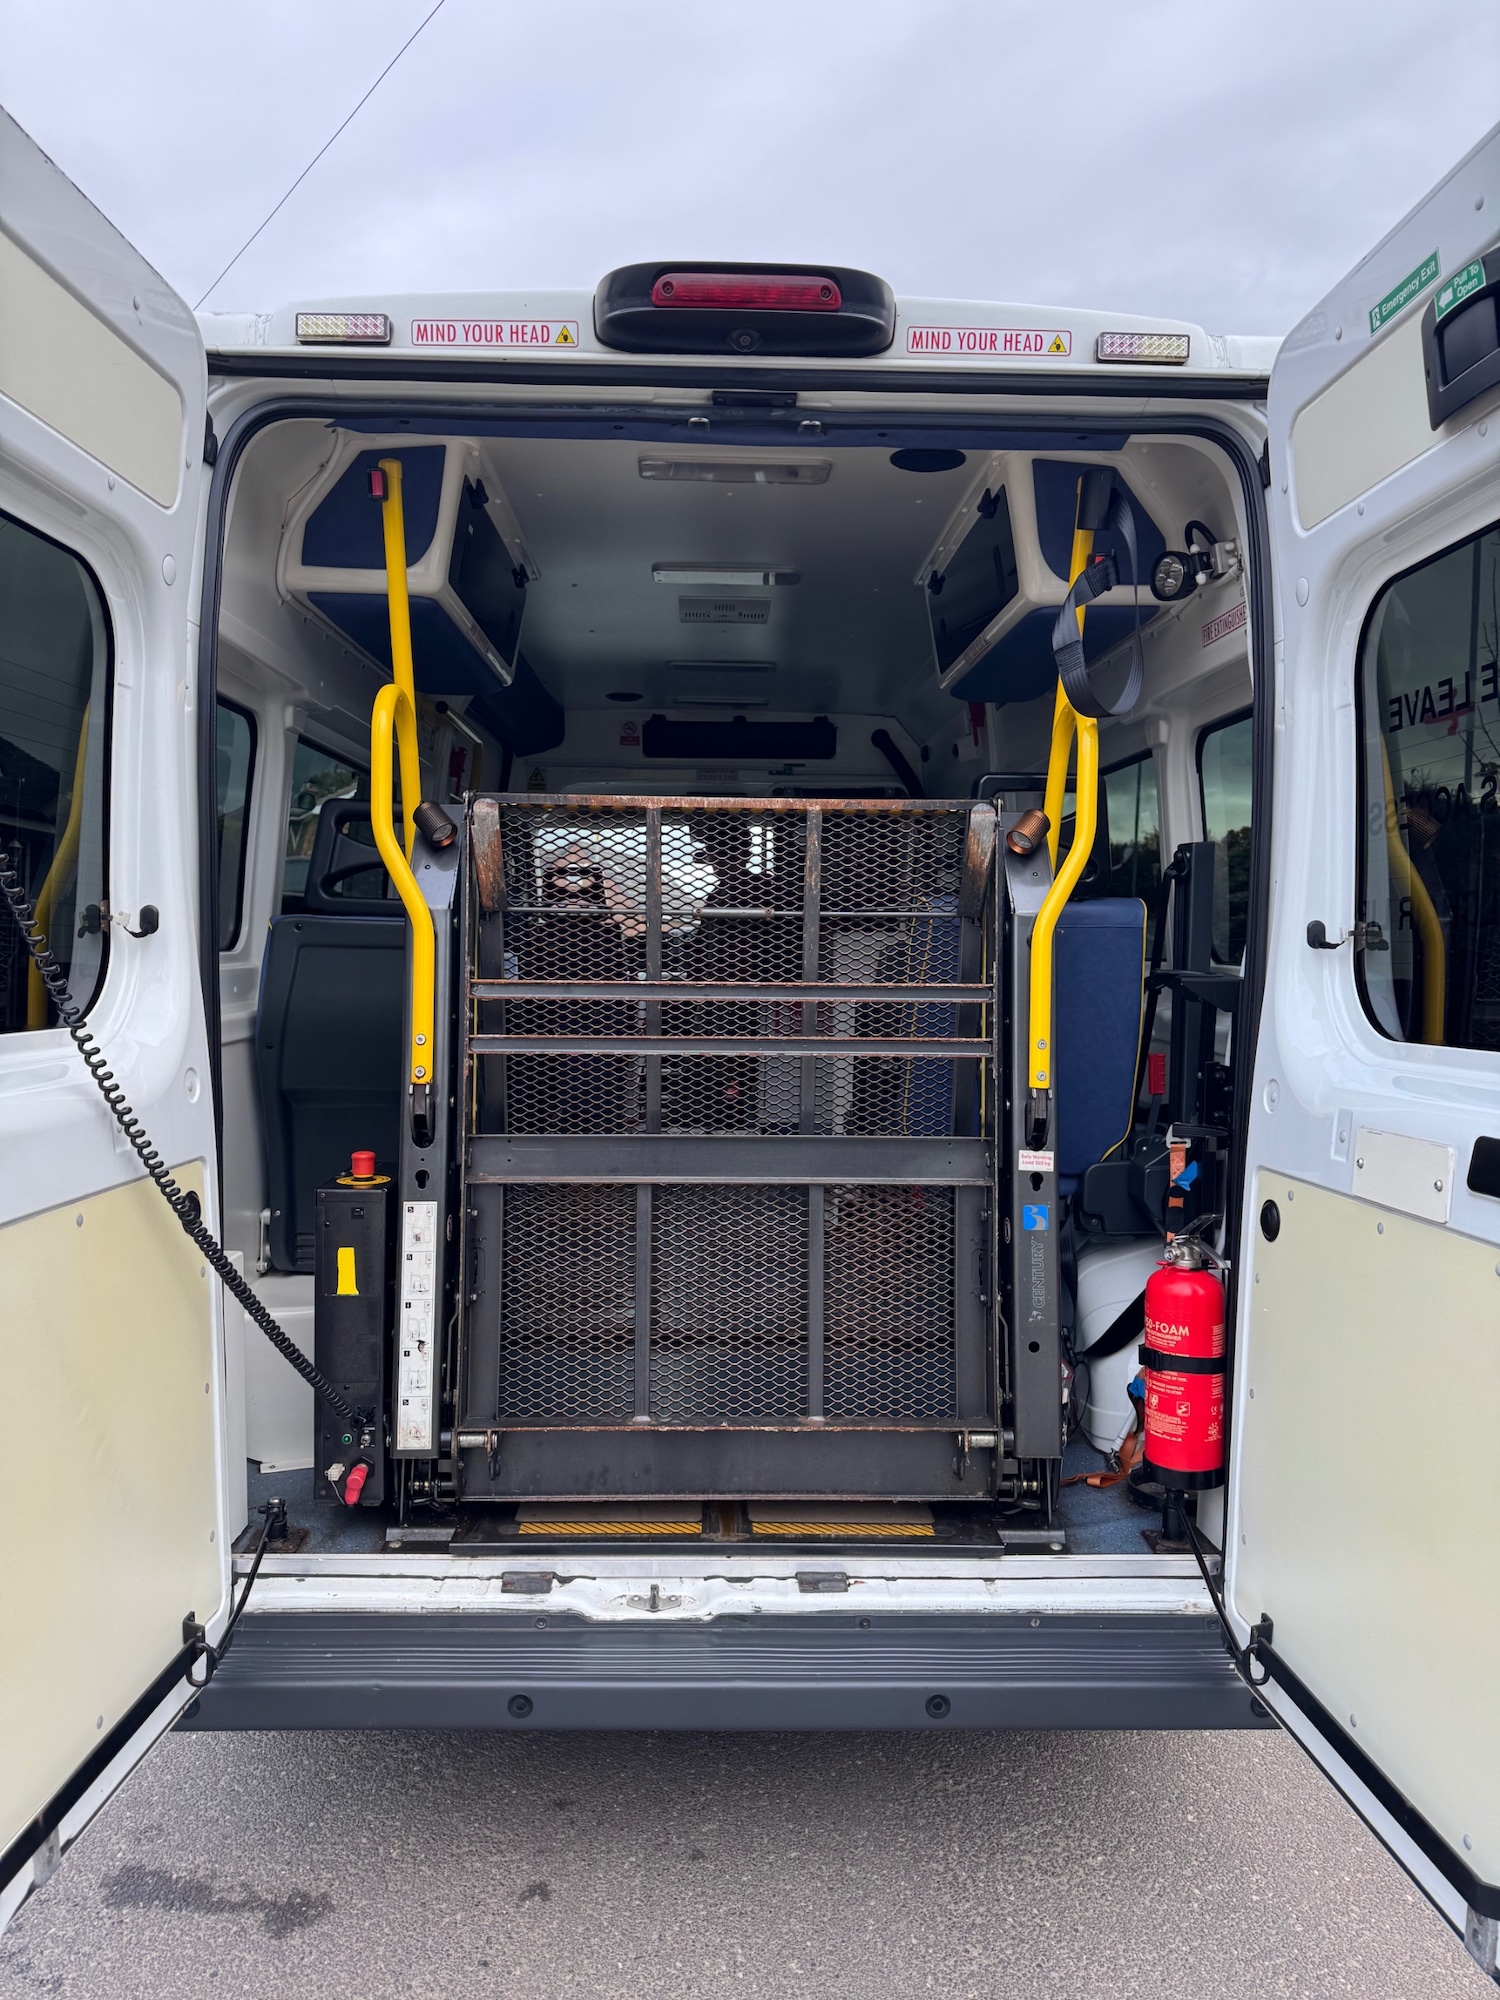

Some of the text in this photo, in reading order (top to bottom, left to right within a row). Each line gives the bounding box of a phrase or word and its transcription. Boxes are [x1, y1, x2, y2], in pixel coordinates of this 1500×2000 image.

[1381, 260, 1436, 316] Emergency Exit
[1453, 264, 1479, 288] Pull To
[1457, 278, 1478, 297] Open
[416, 323, 550, 343] MIND YOUR HEAD
[911, 330, 1043, 352] MIND YOUR HEAD
[1203, 604, 1247, 644] FIRE EXTINGUISHE
[1031, 1239, 1046, 1309] CENTURY
